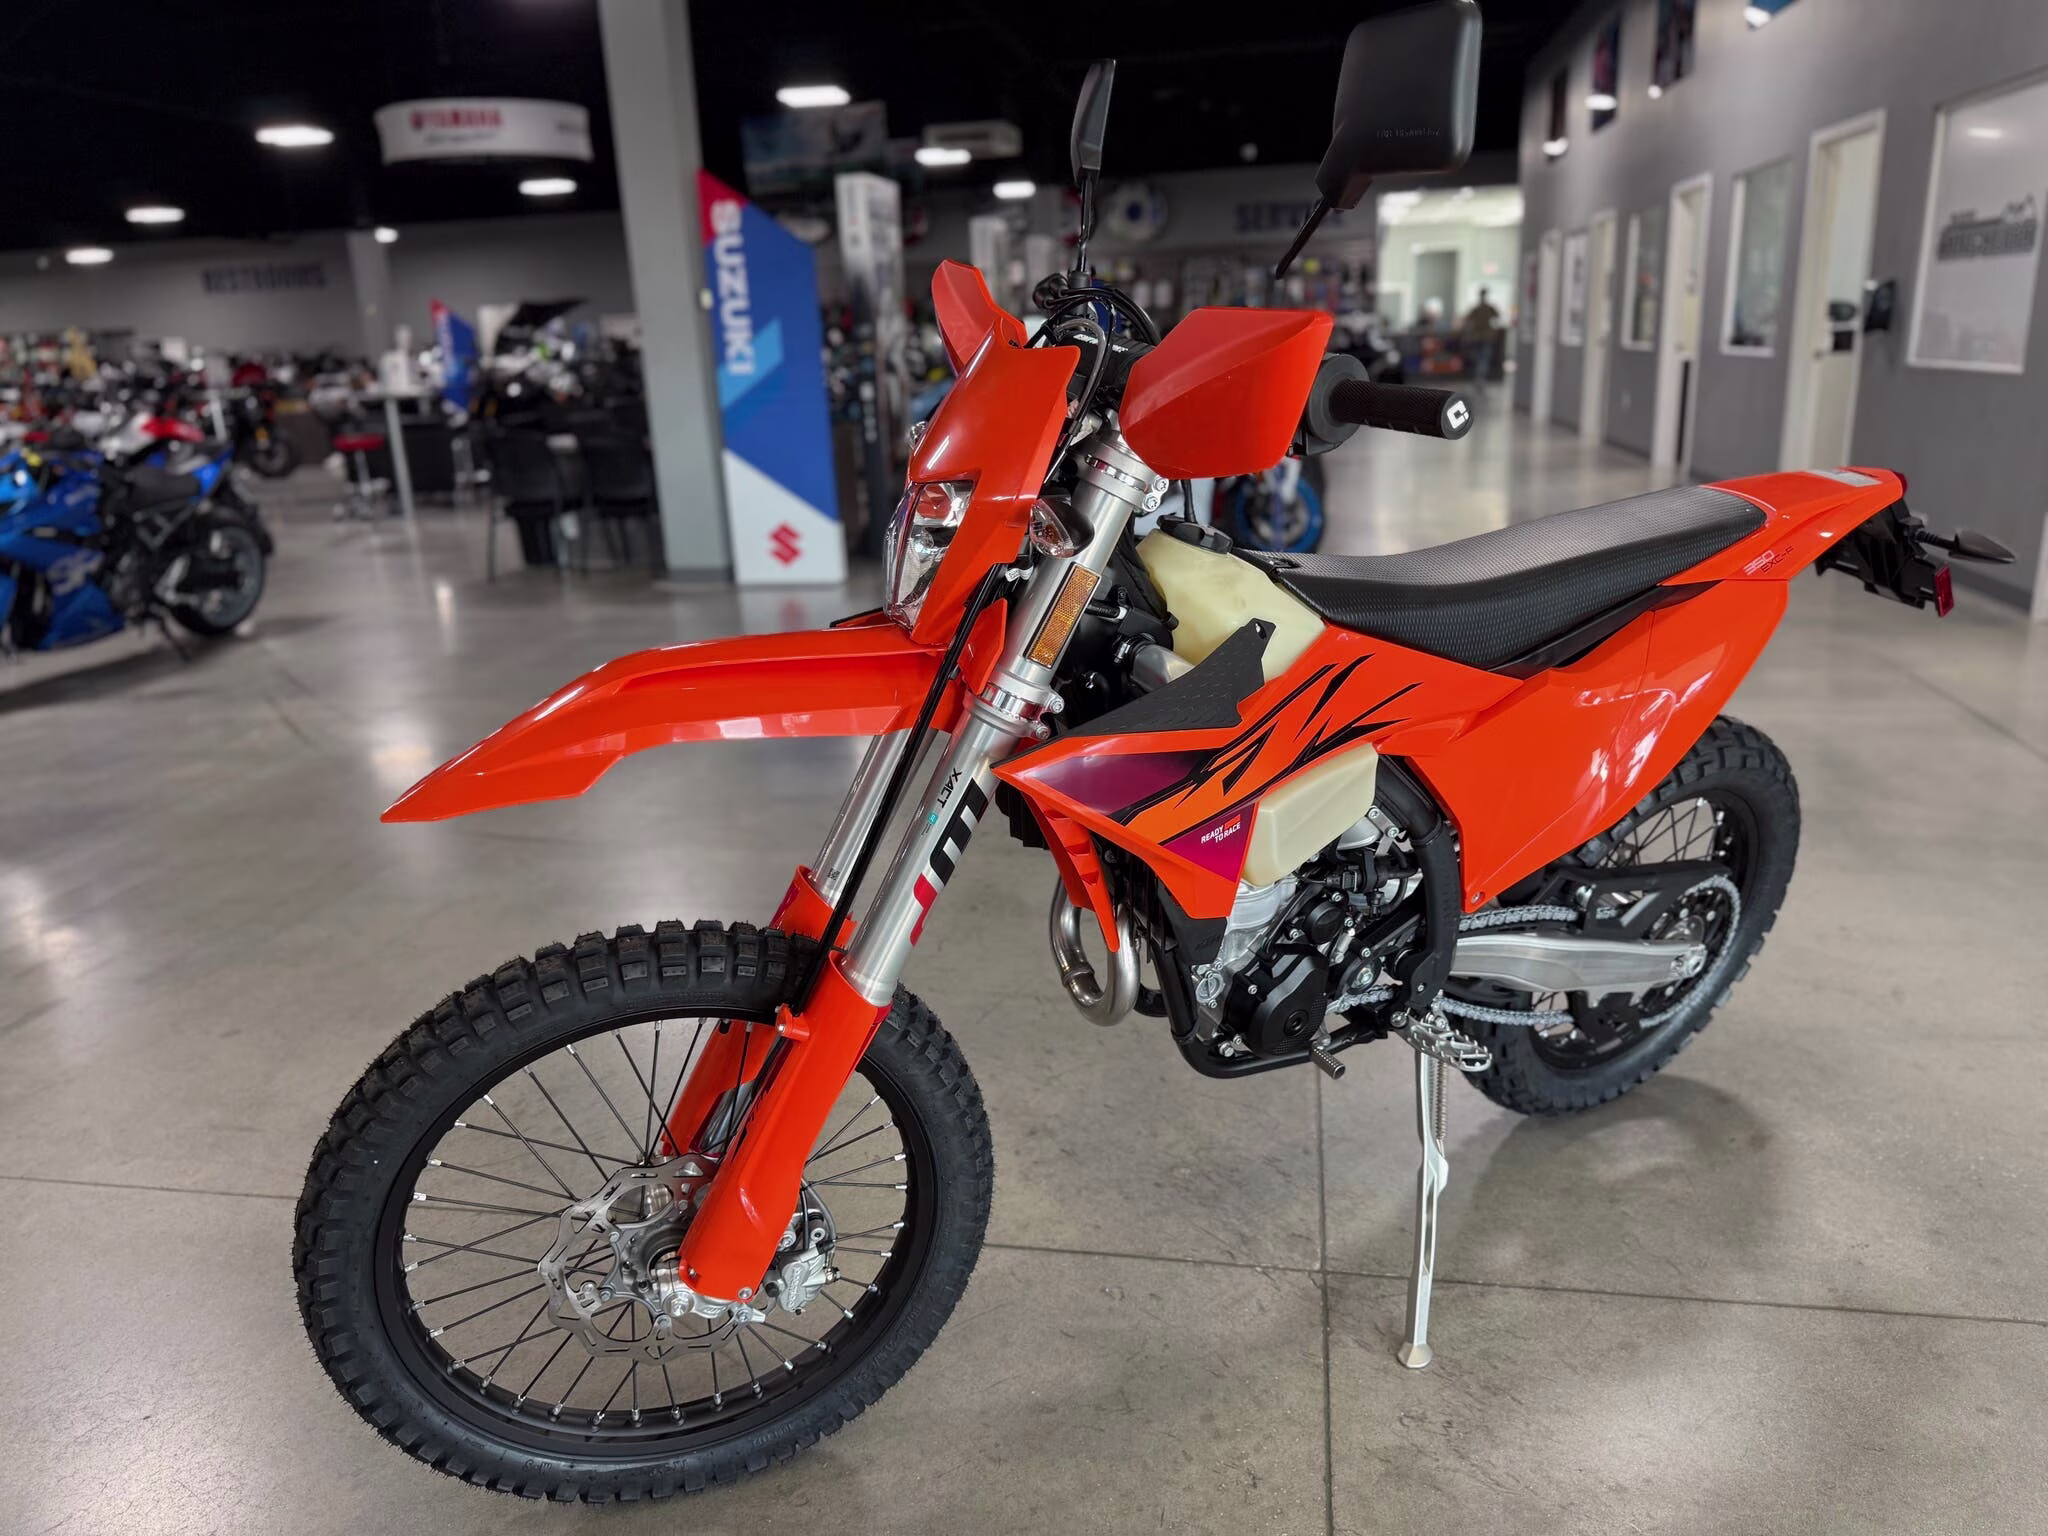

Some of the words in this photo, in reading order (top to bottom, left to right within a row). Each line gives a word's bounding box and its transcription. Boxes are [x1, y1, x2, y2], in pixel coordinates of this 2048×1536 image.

[710, 199, 755, 375] SUZUKI
[1761, 545, 1794, 573] EXC-F
[937, 767, 962, 808] XACT
[1201, 824, 1224, 844] READY
[1215, 832, 1224, 843] TO
[1224, 822, 1241, 838] RACE
